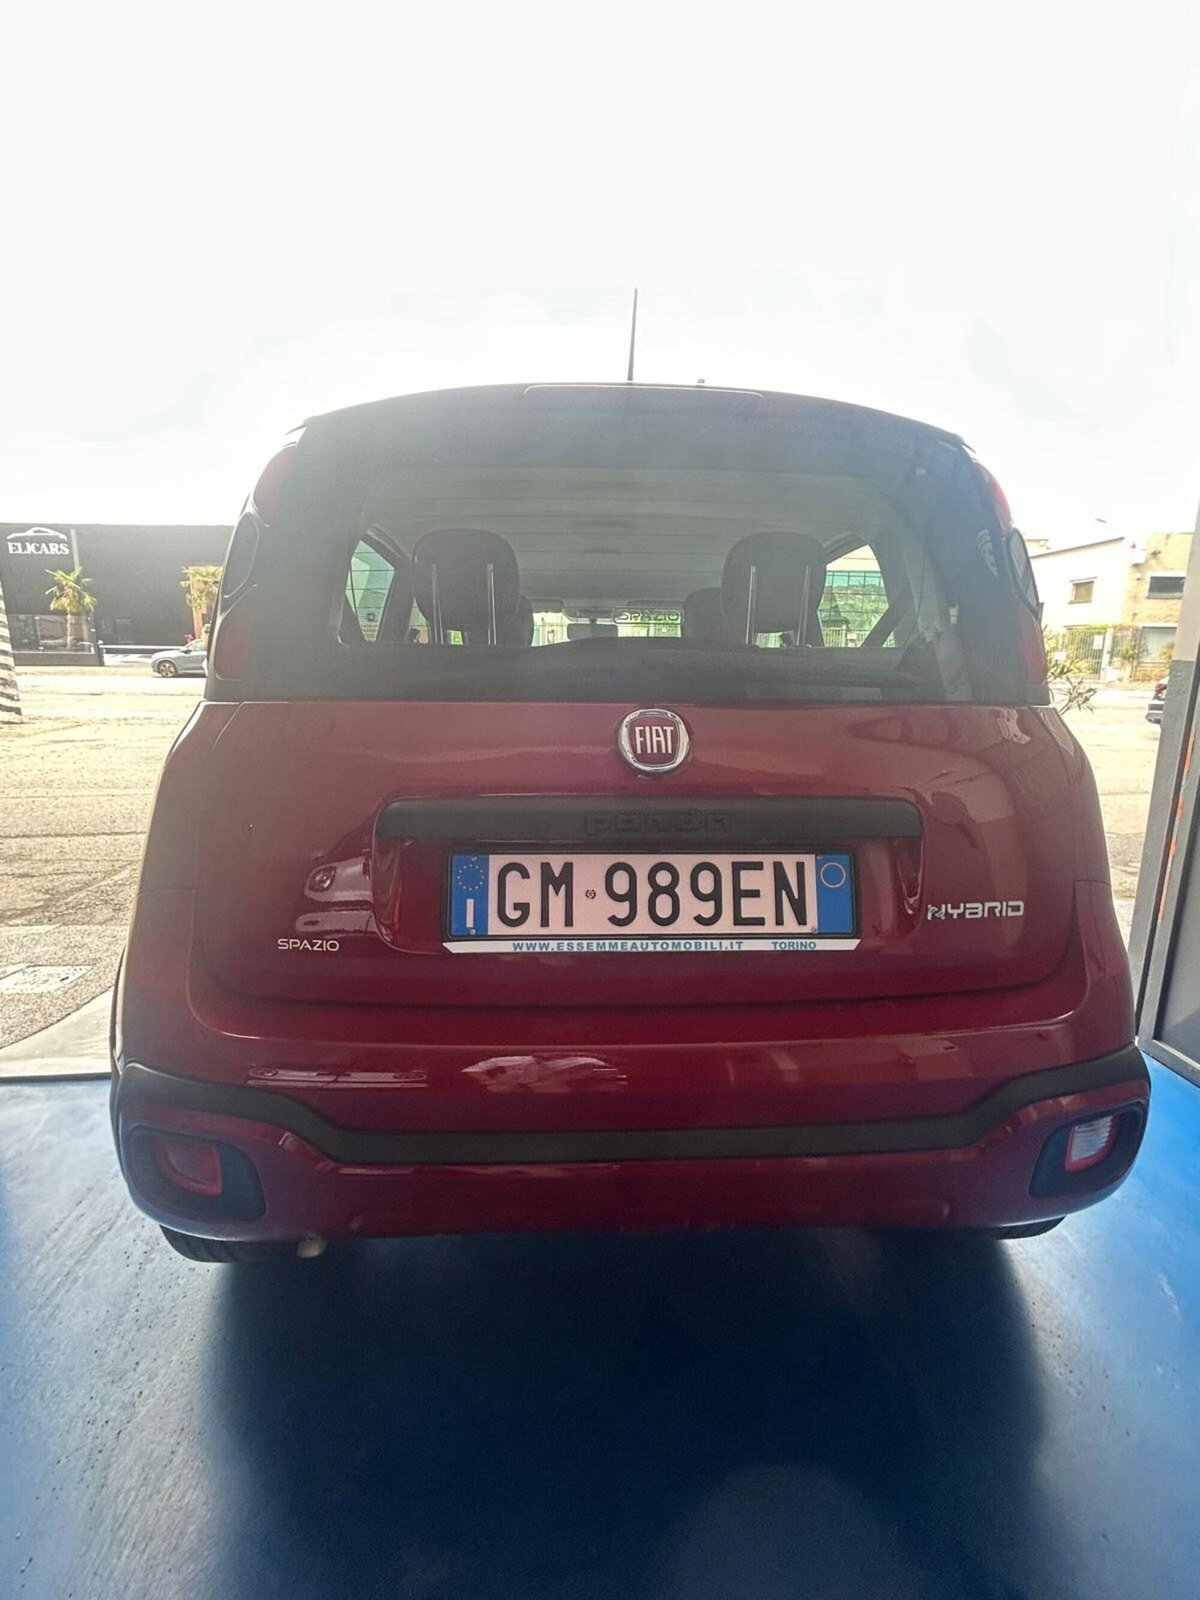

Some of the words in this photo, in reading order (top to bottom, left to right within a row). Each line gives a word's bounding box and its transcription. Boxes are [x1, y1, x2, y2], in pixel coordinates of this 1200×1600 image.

[634, 726, 674, 753] FIAT
[927, 900, 1024, 920] HYBRID
[277, 938, 340, 951] SPAZIO
[512, 941, 744, 951] WWW.ESSEMMEAUTOMOBILI.IT
[771, 941, 817, 950] TORINO
